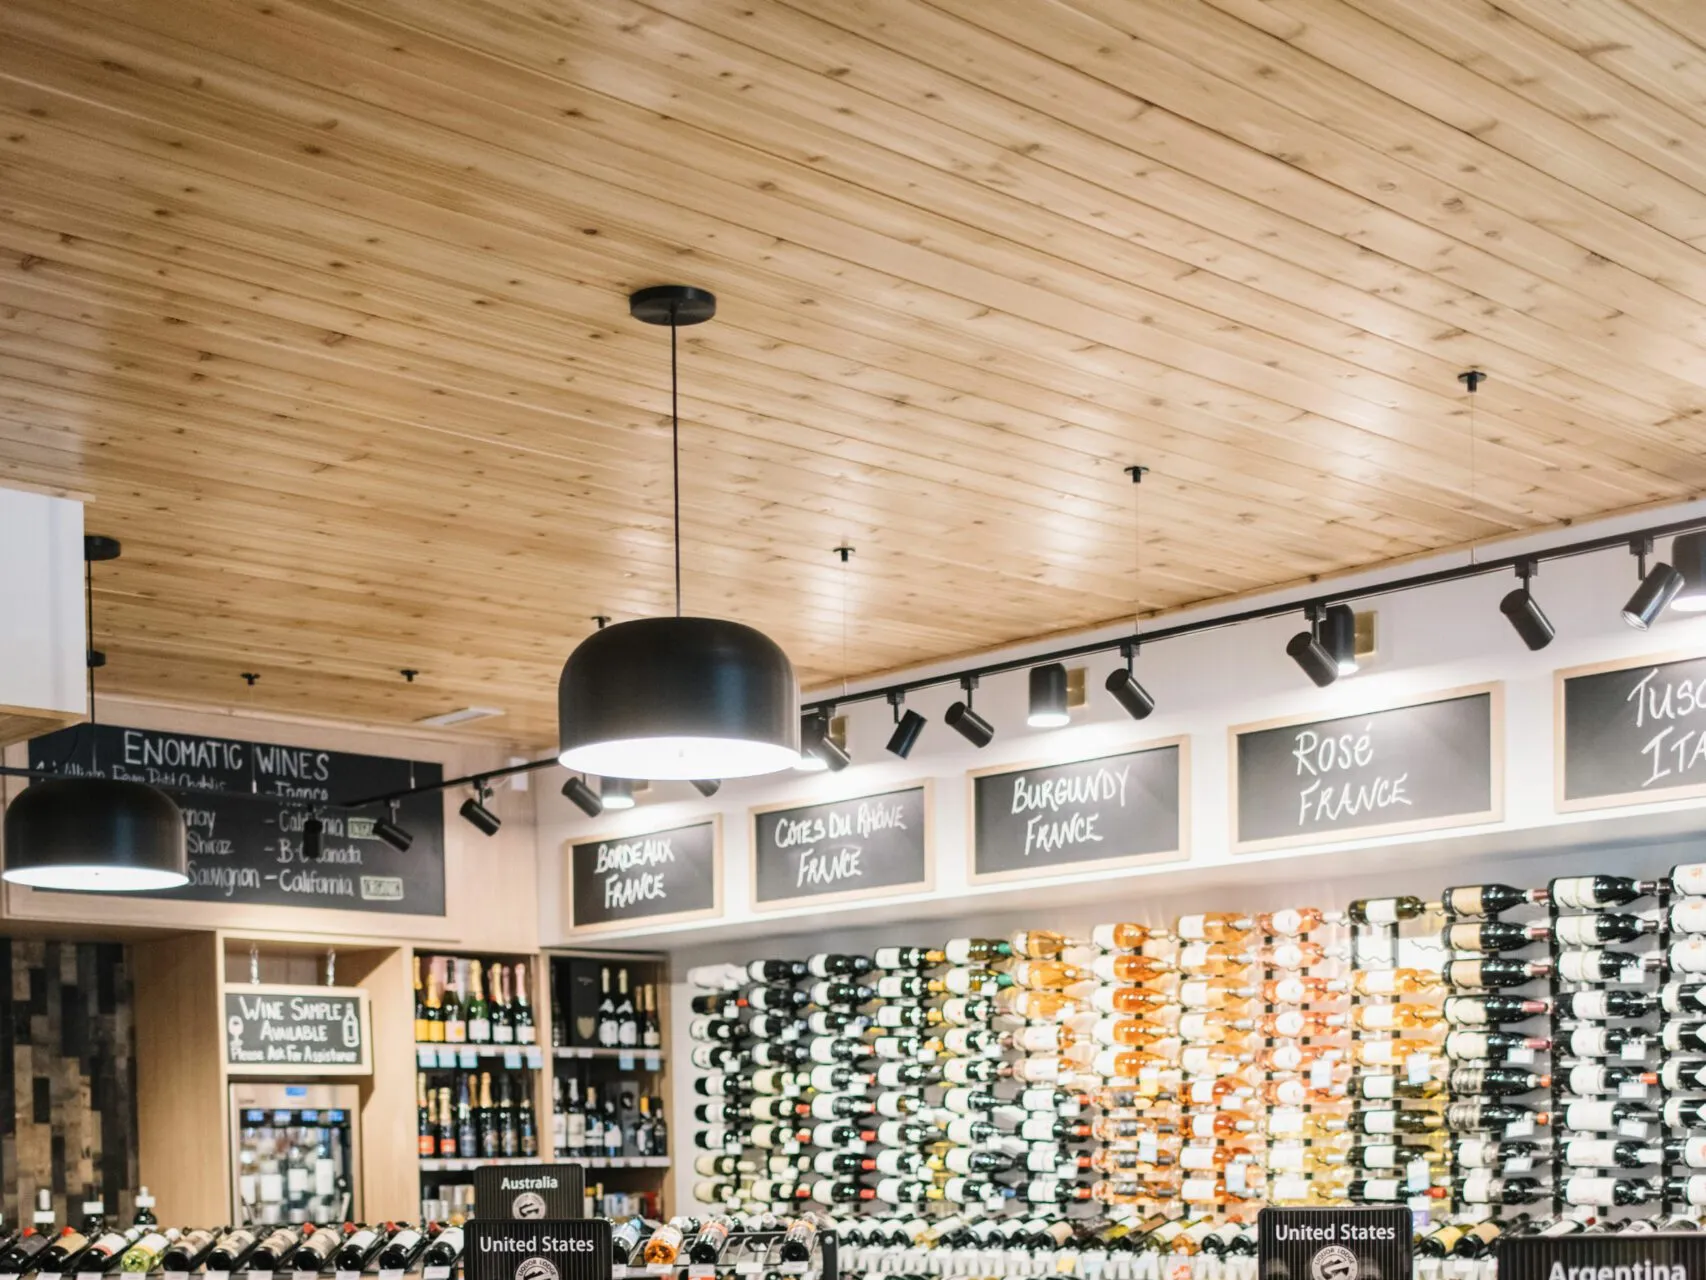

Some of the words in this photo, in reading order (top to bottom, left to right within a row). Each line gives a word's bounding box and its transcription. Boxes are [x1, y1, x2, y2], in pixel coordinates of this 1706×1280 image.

[124, 730, 243, 770] ENOMATIC
[255, 746, 330, 781] WINES
[1011, 764, 1130, 814] BURGUNDY
[1299, 772, 1412, 826] FRANCE
[187, 830, 235, 856] Shiraz
[1024, 812, 1104, 856] FRANCE
[594, 838, 675, 874] BORDEAUX
[796, 848, 863, 888] FRANCE
[188, 860, 260, 897] Sauvignon
[278, 868, 354, 898] California
[604, 872, 667, 909] FRANCE
[239, 995, 285, 1021] WINE
[289, 997, 342, 1021] SAMPLE
[260, 1020, 329, 1042] AVAILABLE
[501, 1176, 559, 1190] Australia
[480, 1236, 537, 1252] United
[541, 1236, 594, 1252] States
[1275, 1223, 1336, 1241] United
[1340, 1223, 1396, 1241] States
